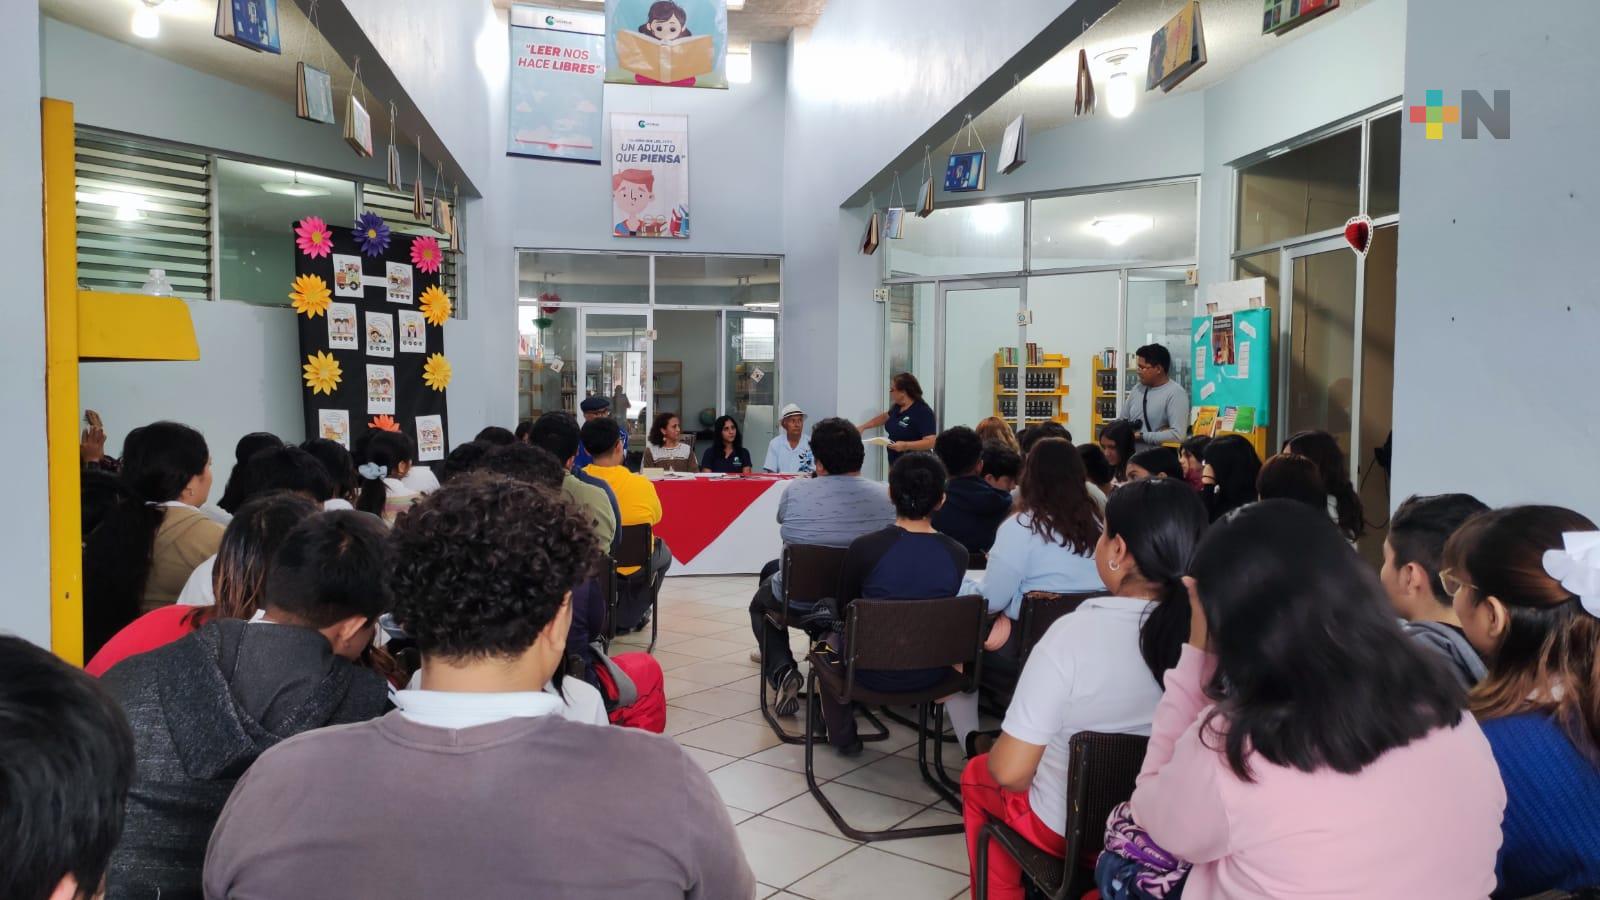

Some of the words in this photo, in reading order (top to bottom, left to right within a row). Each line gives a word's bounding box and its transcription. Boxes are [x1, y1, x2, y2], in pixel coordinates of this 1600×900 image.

[563, 48, 589, 60] NOS
[518, 57, 551, 69] HACE
[621, 143, 636, 152] UN
[637, 143, 676, 153] ADULTO
[615, 152, 639, 163] QUE
